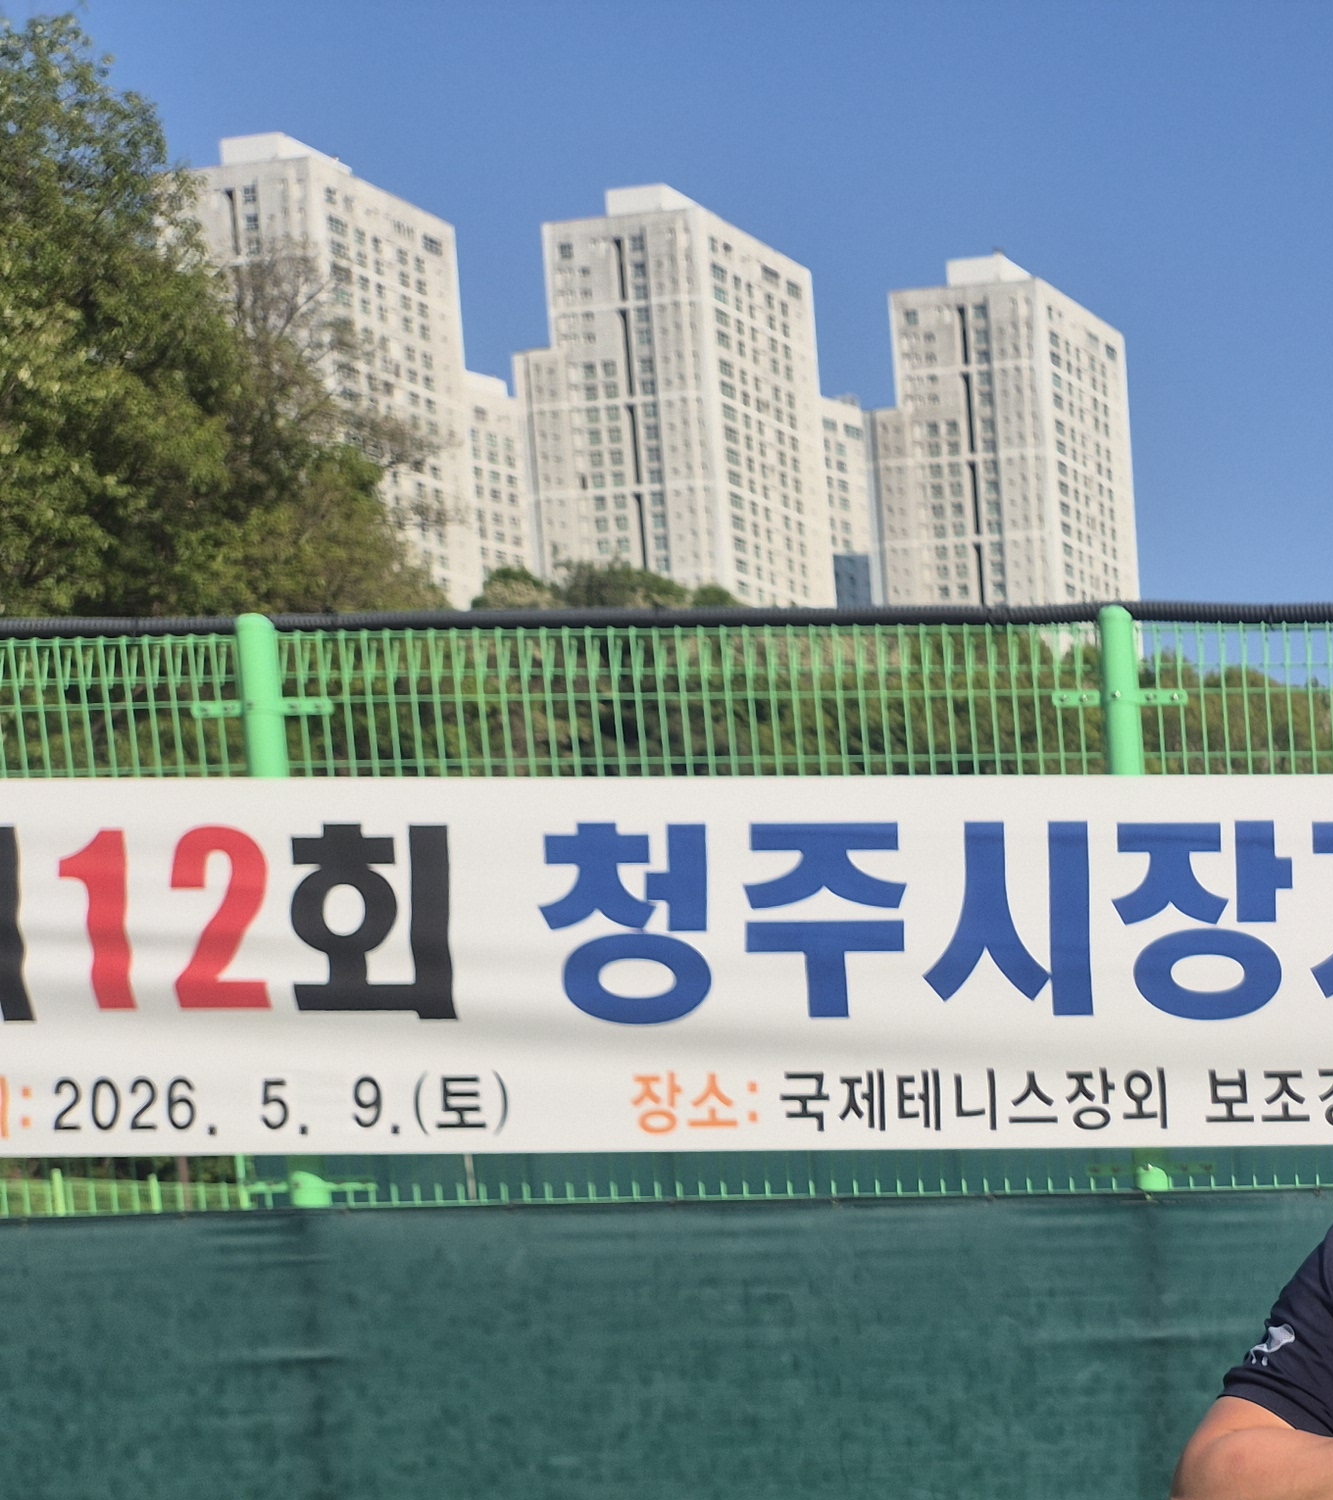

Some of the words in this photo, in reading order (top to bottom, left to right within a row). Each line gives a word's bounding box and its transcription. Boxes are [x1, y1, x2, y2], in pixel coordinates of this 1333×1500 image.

[52, 1075, 218, 1137] 2026.
[630, 1071, 760, 1134] 장소:
[779, 1065, 1169, 1132] 국제테니스장외
